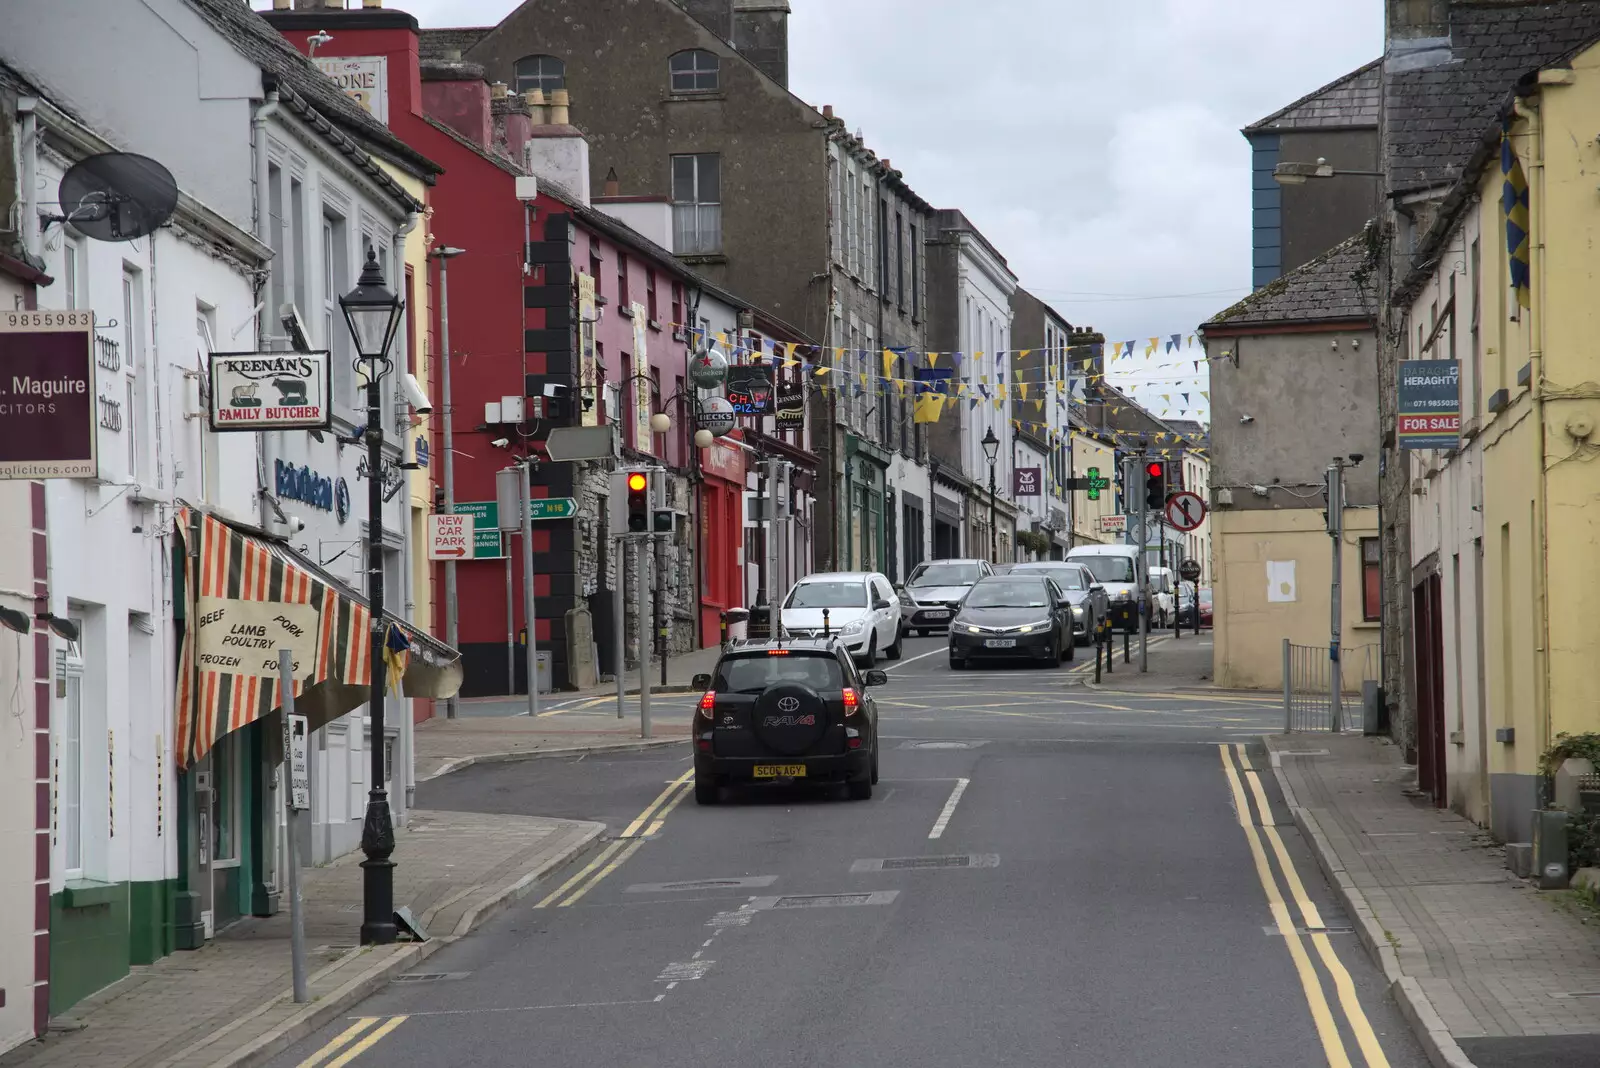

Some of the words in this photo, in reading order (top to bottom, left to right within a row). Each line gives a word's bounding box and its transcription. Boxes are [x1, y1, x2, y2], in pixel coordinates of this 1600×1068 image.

[8, 313, 90, 327] 9855983
[692, 369, 724, 377] Heineken
[1404, 367, 1449, 376] DARAGH
[1404, 376, 1458, 386] HERAGHTY
[12, 375, 86, 399] Maguire
[1413, 400, 1427, 408] 071
[218, 408, 261, 421] FAMILY
[265, 406, 320, 419] BUTCHER
[1404, 419, 1427, 430] FOR
[1430, 418, 1459, 429] SALE
[1018, 484, 1036, 493] AIB
[437, 516, 464, 526] NEW
[438, 526, 463, 536] CAR
[435, 537, 467, 546] PARK
[200, 608, 225, 629] BEEF
[273, 615, 304, 638] PORK
[230, 623, 267, 637] LAMB
[222, 635, 276, 650] POULTRY
[200, 654, 241, 668] FROZEN
[262, 659, 300, 672] FOS
[763, 714, 816, 727] RAV4
[783, 765, 802, 776] AGY
